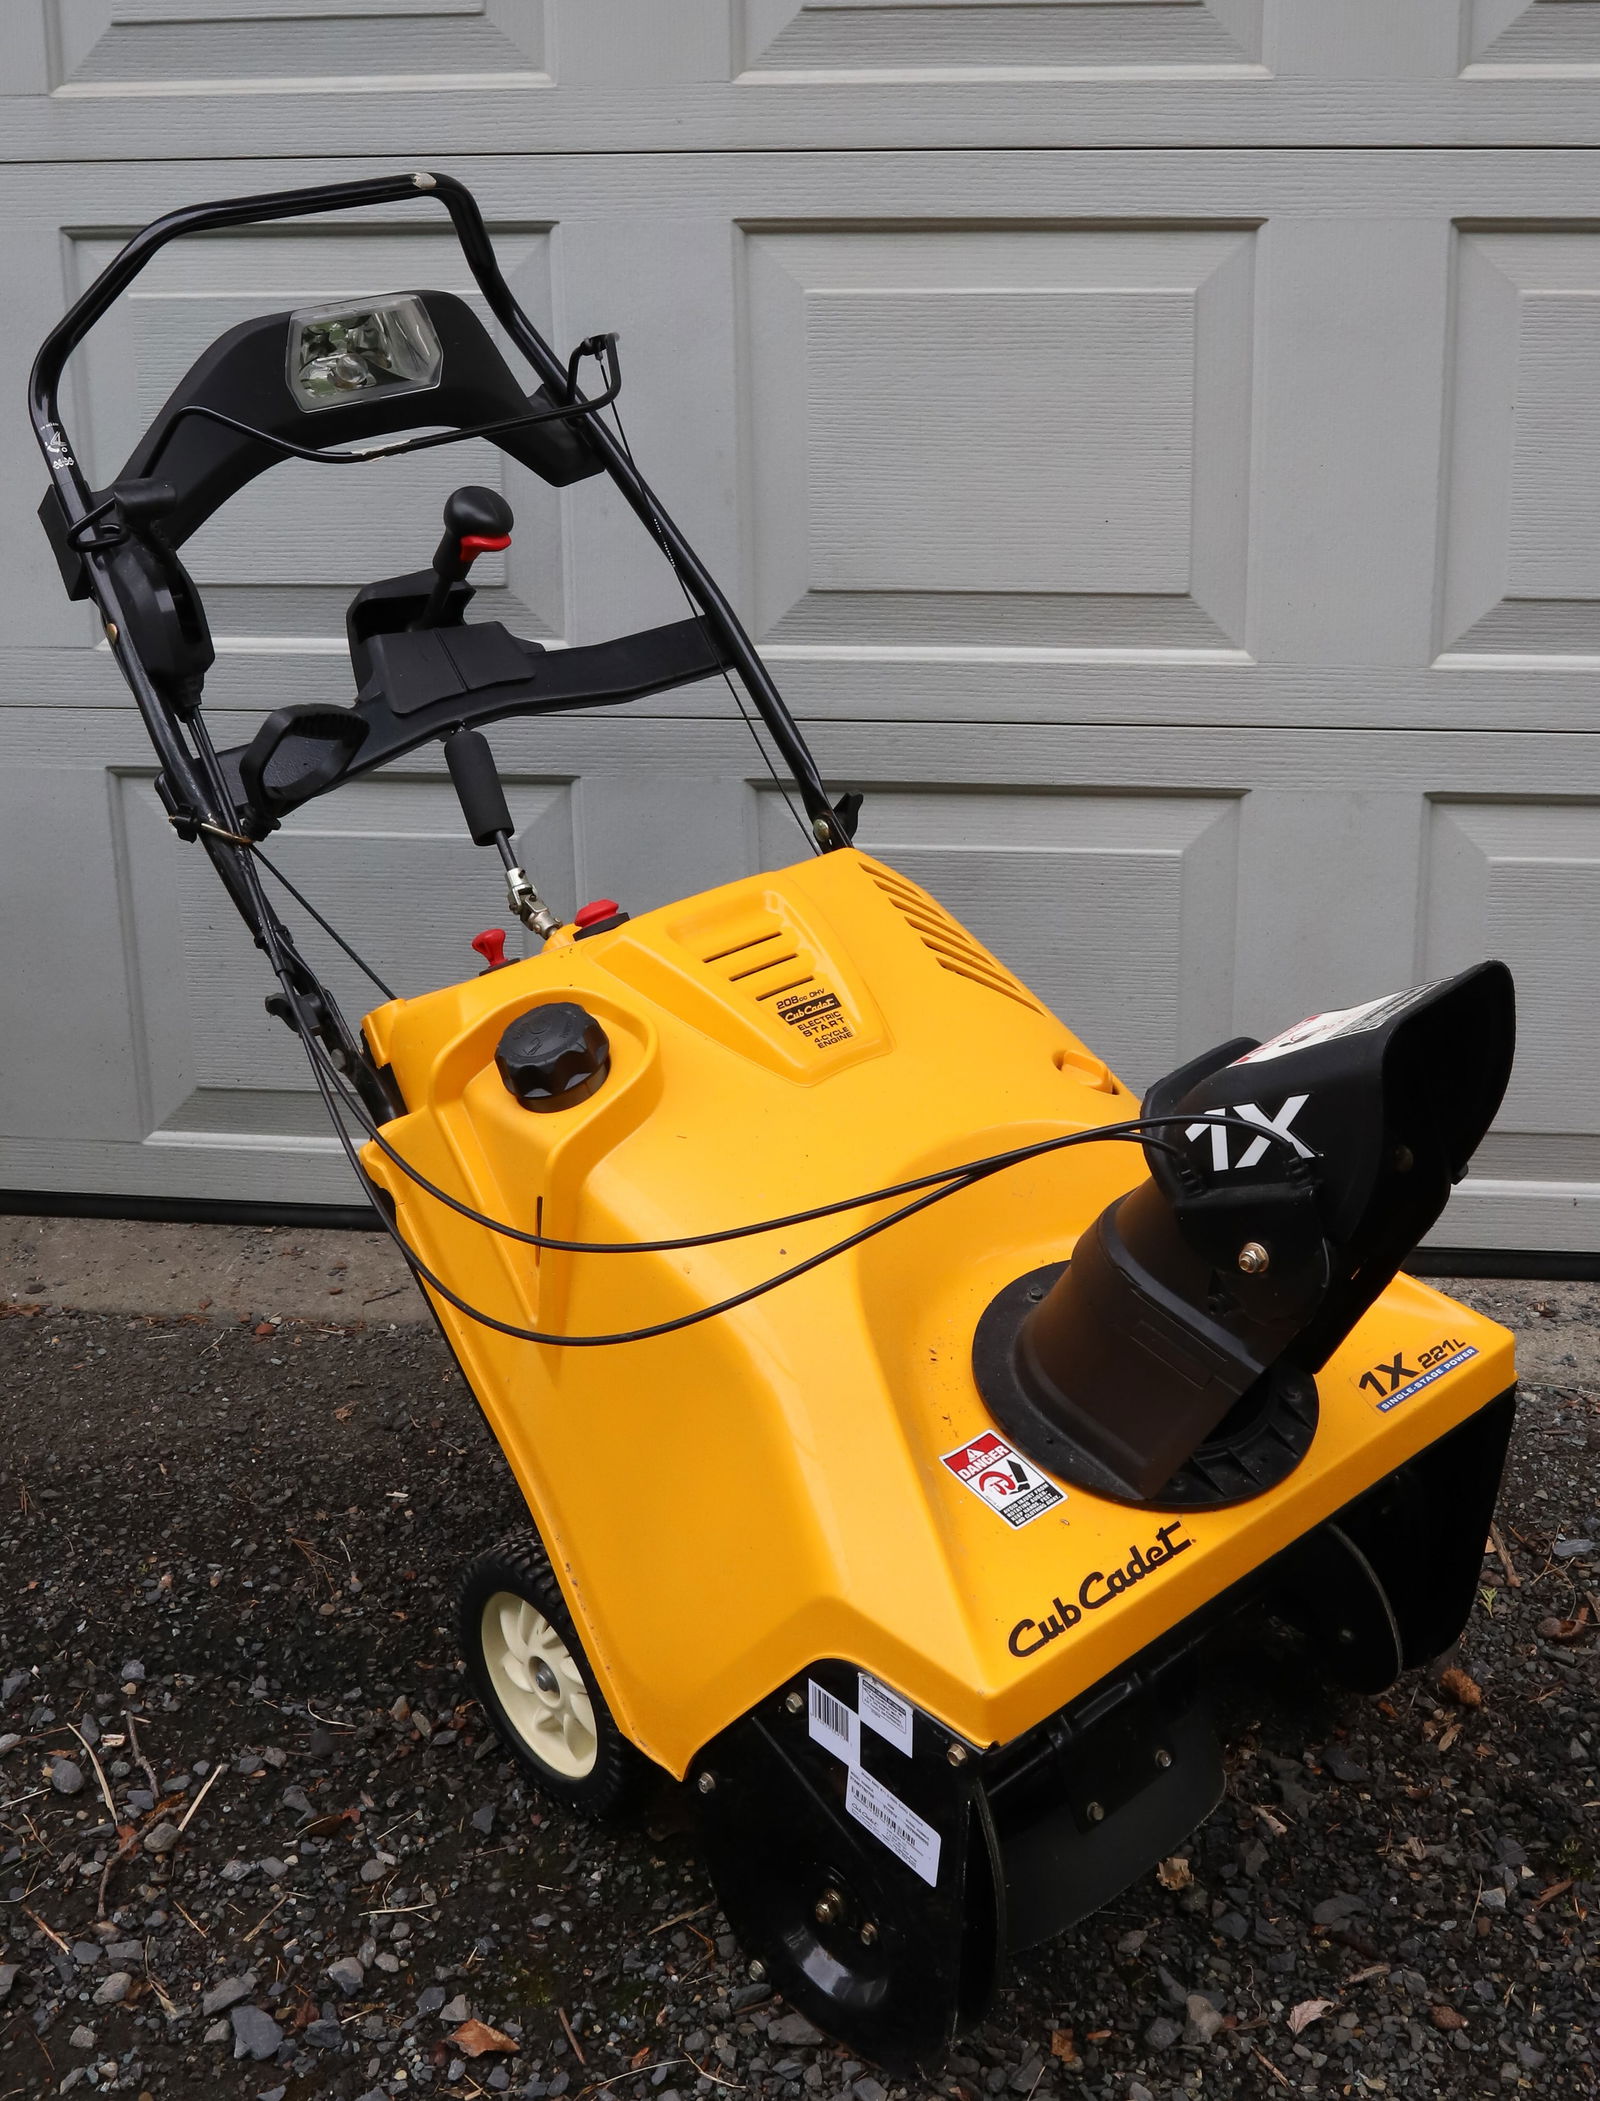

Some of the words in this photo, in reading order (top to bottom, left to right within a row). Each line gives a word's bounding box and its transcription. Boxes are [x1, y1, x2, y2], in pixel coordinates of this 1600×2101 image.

[809, 988, 825, 998] OHV
[785, 1008, 805, 1022] Cub
[804, 998, 835, 1015] Cadet
[797, 1011, 842, 1031] ELECTRIC
[802, 1016, 846, 1037] START
[814, 1026, 849, 1043] 4-CYCLE
[817, 1031, 854, 1049] ENGINE
[1184, 1093, 1317, 1172] 1X
[1358, 1351, 1420, 1397] 1X
[1380, 1368, 1444, 1410] SINGLE-STAGE
[1443, 1348, 1476, 1369] POWER
[957, 1444, 1010, 1480] DANGER
[1003, 1502, 1019, 1514] AVOID
[1016, 1491, 1035, 1505] INJURY
[1033, 1482, 1050, 1495] FROM
[1006, 1500, 1031, 1517] ROTATING
[1010, 1511, 1023, 1521] KEEP
[1040, 1492, 1053, 1503] FEET
[1015, 1516, 1026, 1525] AND
[1024, 1503, 1047, 1519] CLOTHING
[1008, 1596, 1082, 1658] Cub
[1078, 1520, 1193, 1610] Cadet
